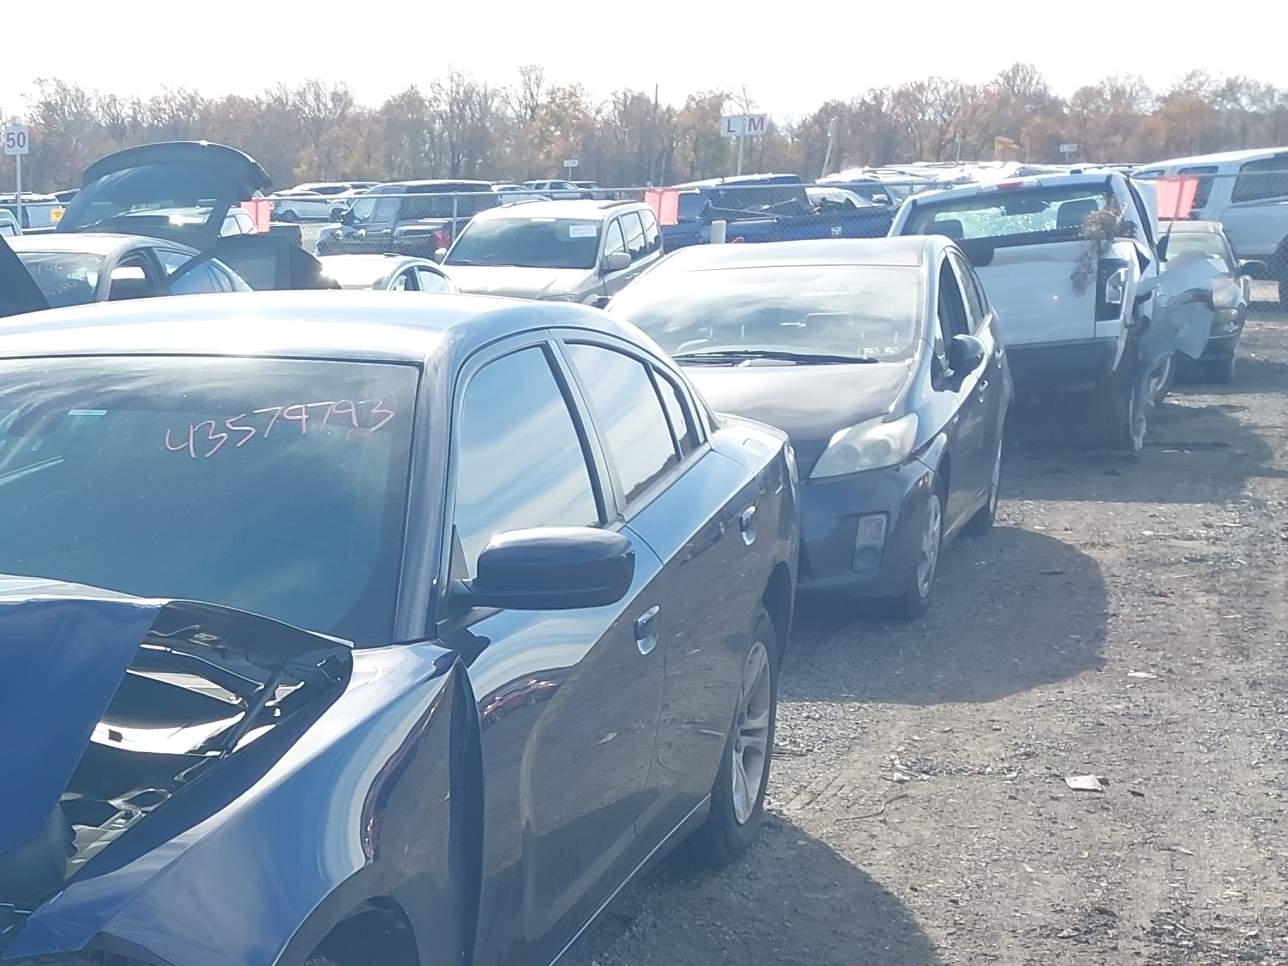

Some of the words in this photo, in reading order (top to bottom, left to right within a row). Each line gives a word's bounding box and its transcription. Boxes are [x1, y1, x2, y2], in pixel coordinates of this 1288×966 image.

[727, 118, 736, 133] L
[748, 116, 765, 132] M
[6, 131, 26, 149] 50
[165, 399, 394, 458] 43579793
